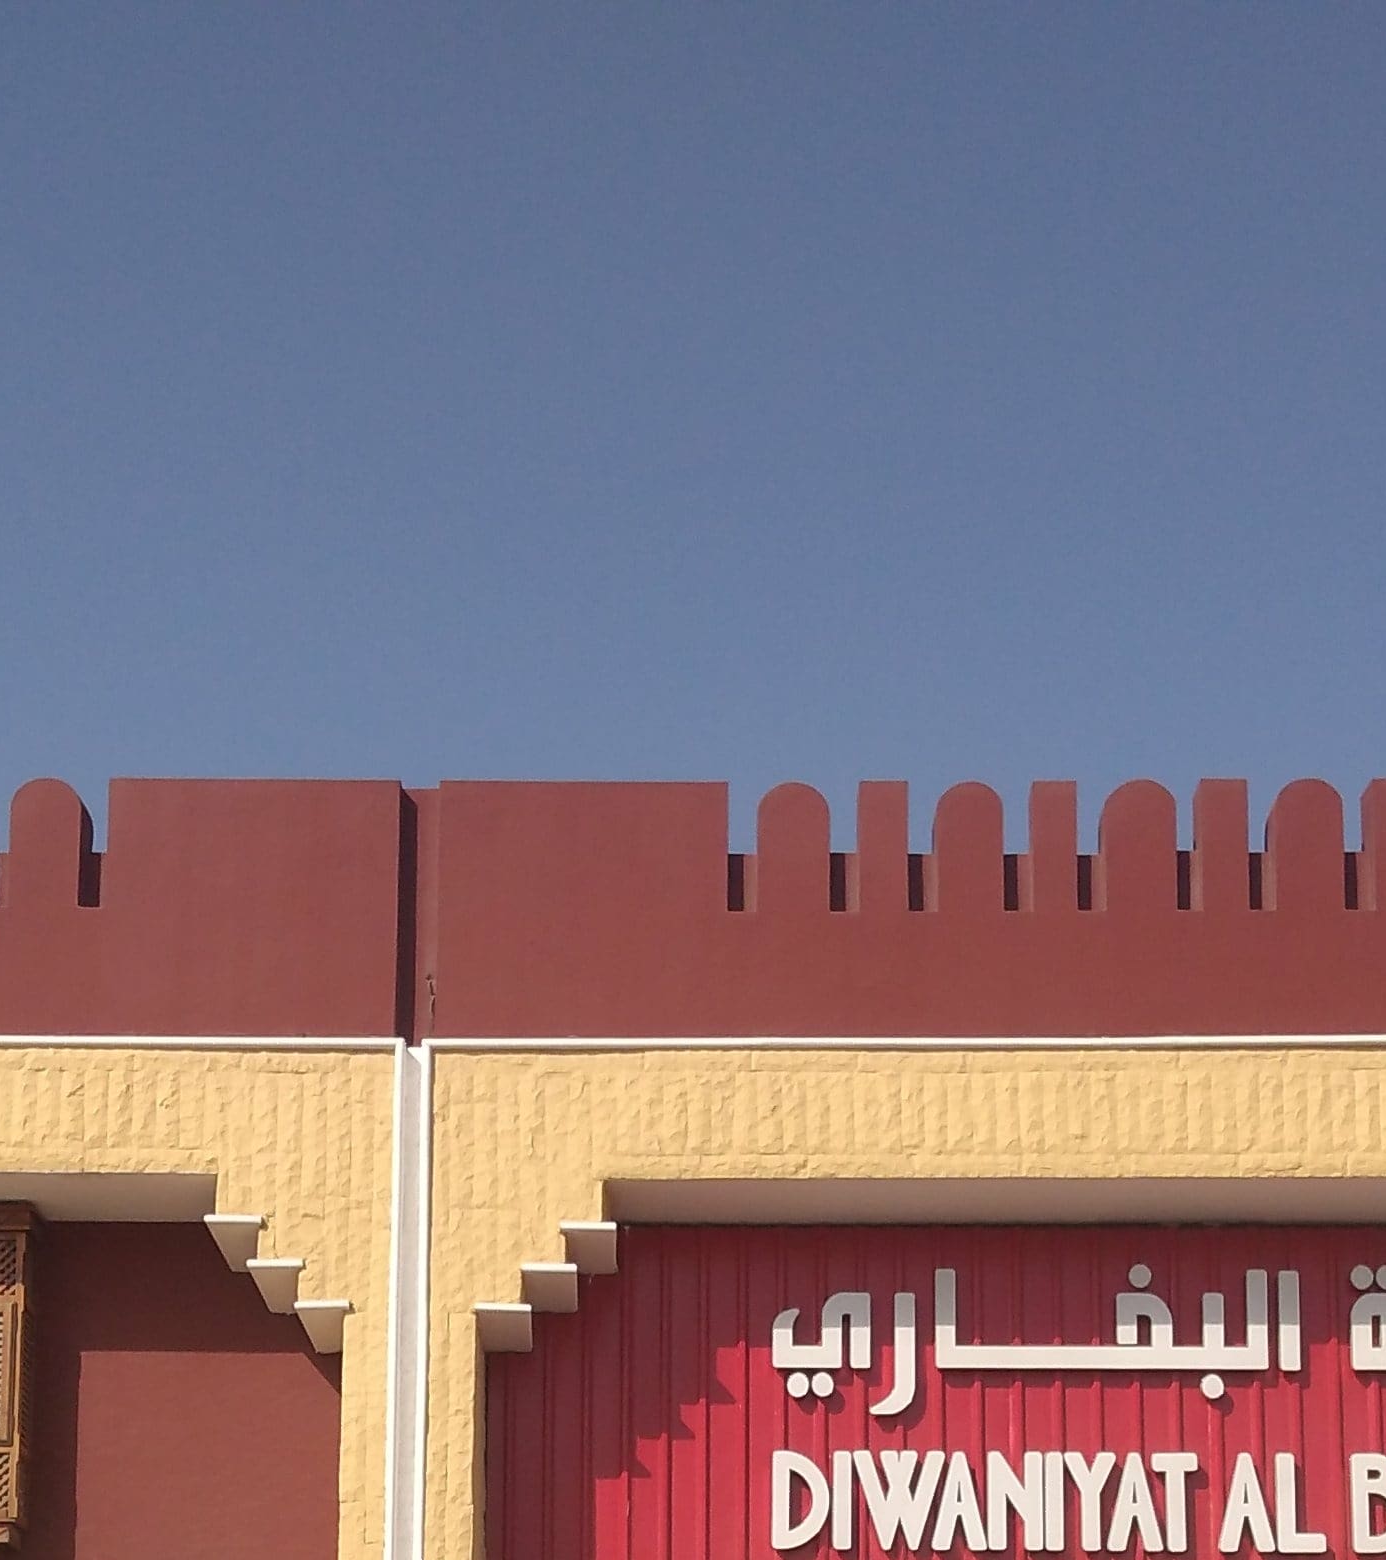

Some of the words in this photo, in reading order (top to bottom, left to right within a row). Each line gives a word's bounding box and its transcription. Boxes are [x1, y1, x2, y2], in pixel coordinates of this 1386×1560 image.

[771, 1263, 1302, 1416] البخاري
[771, 1450, 1199, 1553] DIWANIYAT
[1218, 1452, 1328, 1553] AL
